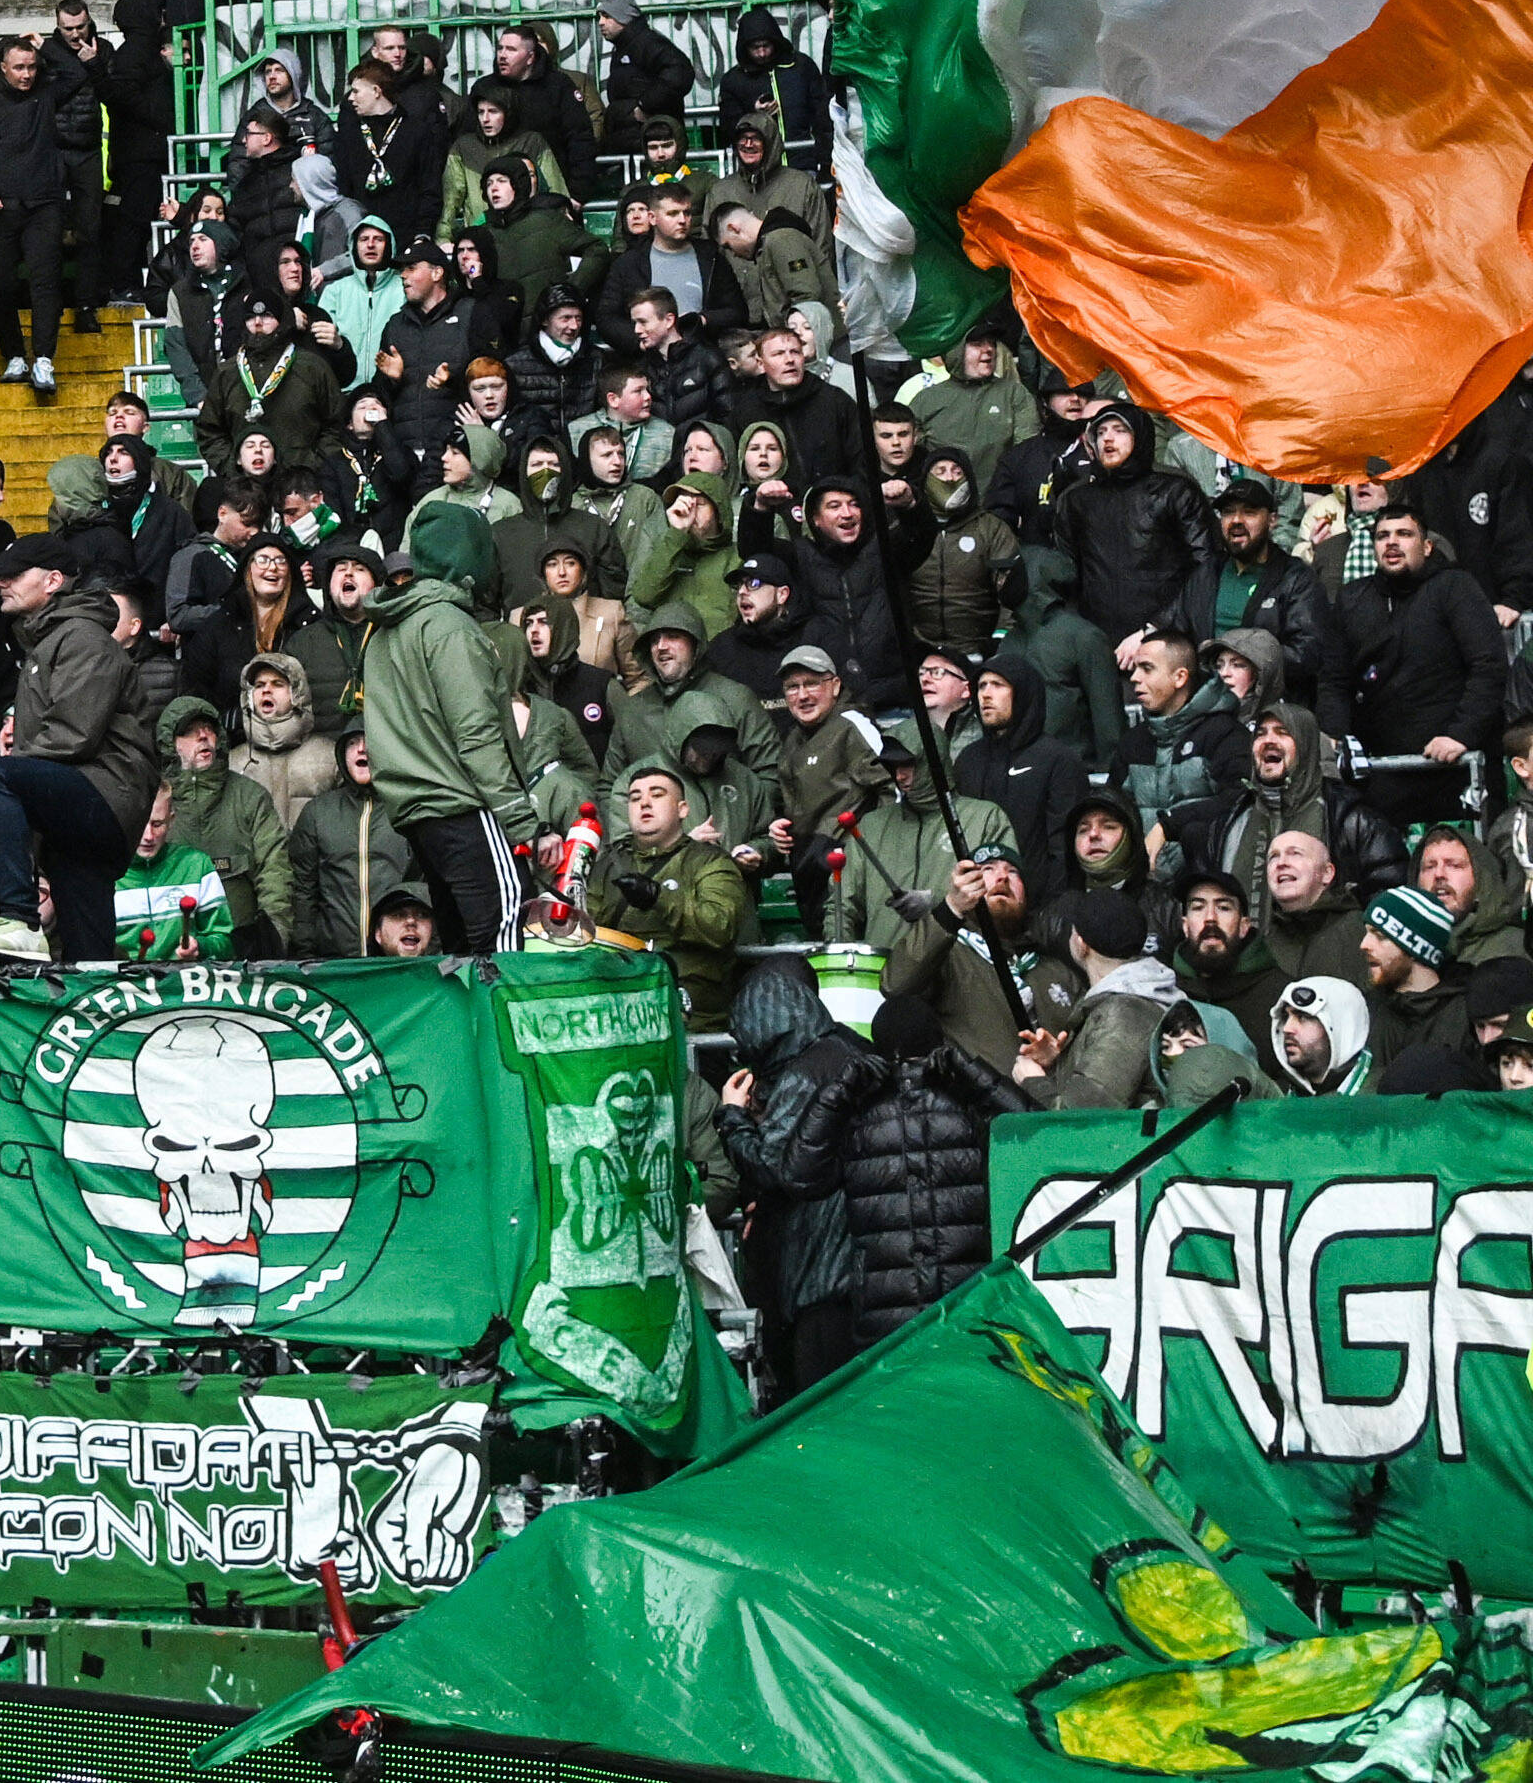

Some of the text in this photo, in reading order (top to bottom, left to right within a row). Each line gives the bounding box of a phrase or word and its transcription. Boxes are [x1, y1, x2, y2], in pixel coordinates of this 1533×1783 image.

[1369, 906, 1445, 965] CELTIC
[33, 965, 387, 1093] GREEN BRIGADE
[517, 1005, 623, 1044] NORTH
